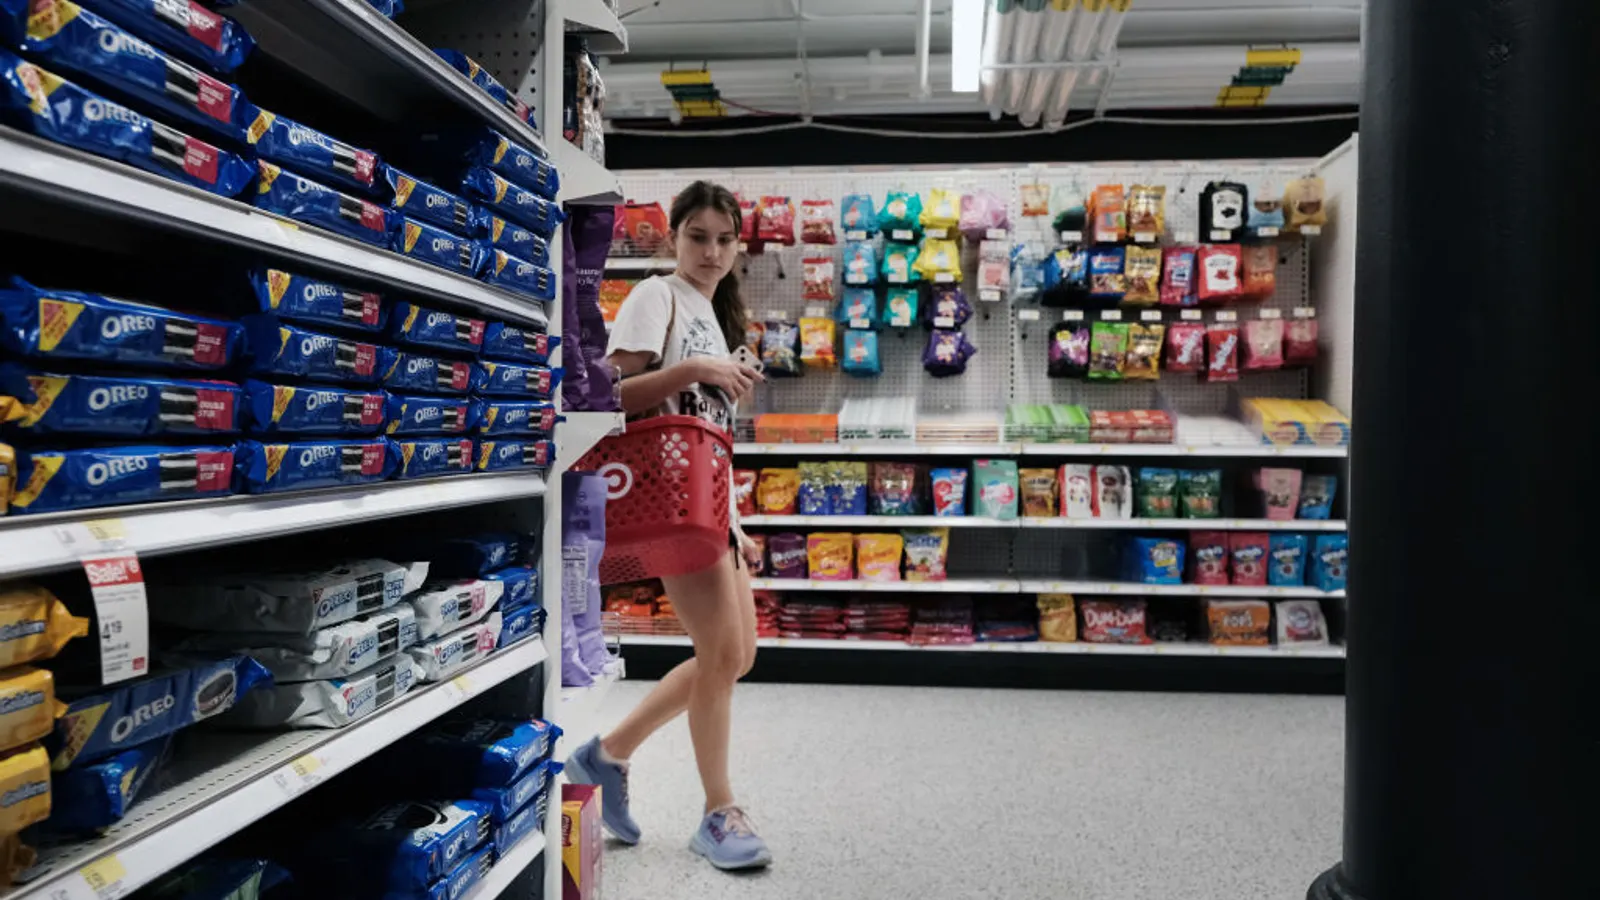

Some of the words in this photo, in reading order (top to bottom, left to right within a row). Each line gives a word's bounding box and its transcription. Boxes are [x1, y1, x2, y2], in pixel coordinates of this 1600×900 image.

[83, 99, 141, 126] OREO
[426, 193, 450, 208] OREO
[432, 237, 455, 253] OREO
[303, 284, 337, 303] OREO
[101, 315, 156, 340] OREO
[427, 313, 451, 328] OREO
[301, 336, 333, 357] OREO
[407, 359, 434, 374] OREO
[502, 369, 523, 382] OREO
[88, 385, 149, 411] OREO
[306, 391, 339, 411] OREO
[414, 407, 439, 423] OREO
[504, 408, 526, 424] OREO
[299, 444, 336, 468] OREO
[423, 443, 444, 461] OREO
[499, 443, 520, 459] OREO
[86, 456, 148, 486] OREO
[85, 560, 128, 582] Sale!
[317, 589, 354, 619] OREO
[110, 694, 175, 744] OREO
[445, 830, 471, 860] OREO
